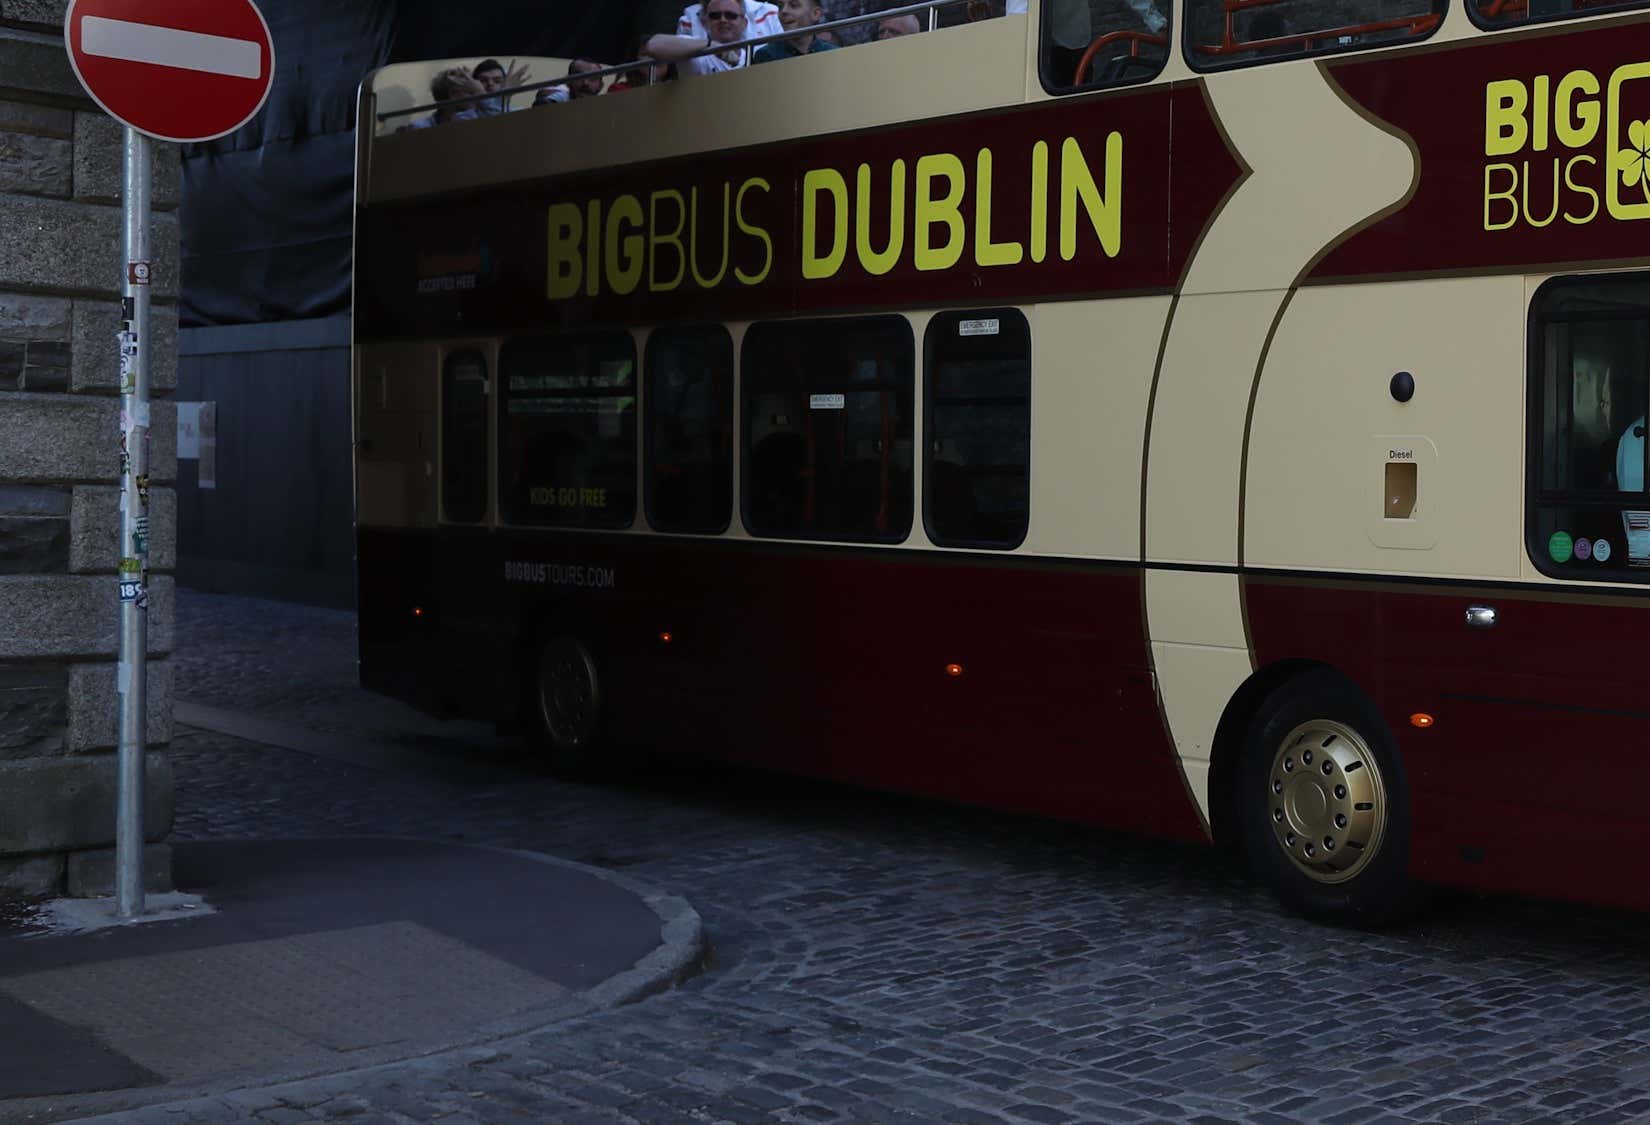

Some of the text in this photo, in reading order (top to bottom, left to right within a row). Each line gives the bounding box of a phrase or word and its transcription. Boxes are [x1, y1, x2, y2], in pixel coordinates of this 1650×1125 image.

[1485, 69, 1601, 156] BIG
[801, 131, 1124, 280] DUBLIN
[1484, 155, 1600, 231] BUS
[1389, 450, 1412, 459] Diesel
[530, 487, 608, 509] KIDS GO FREE
[504, 560, 615, 588] BIGBUSTOURS.COM
